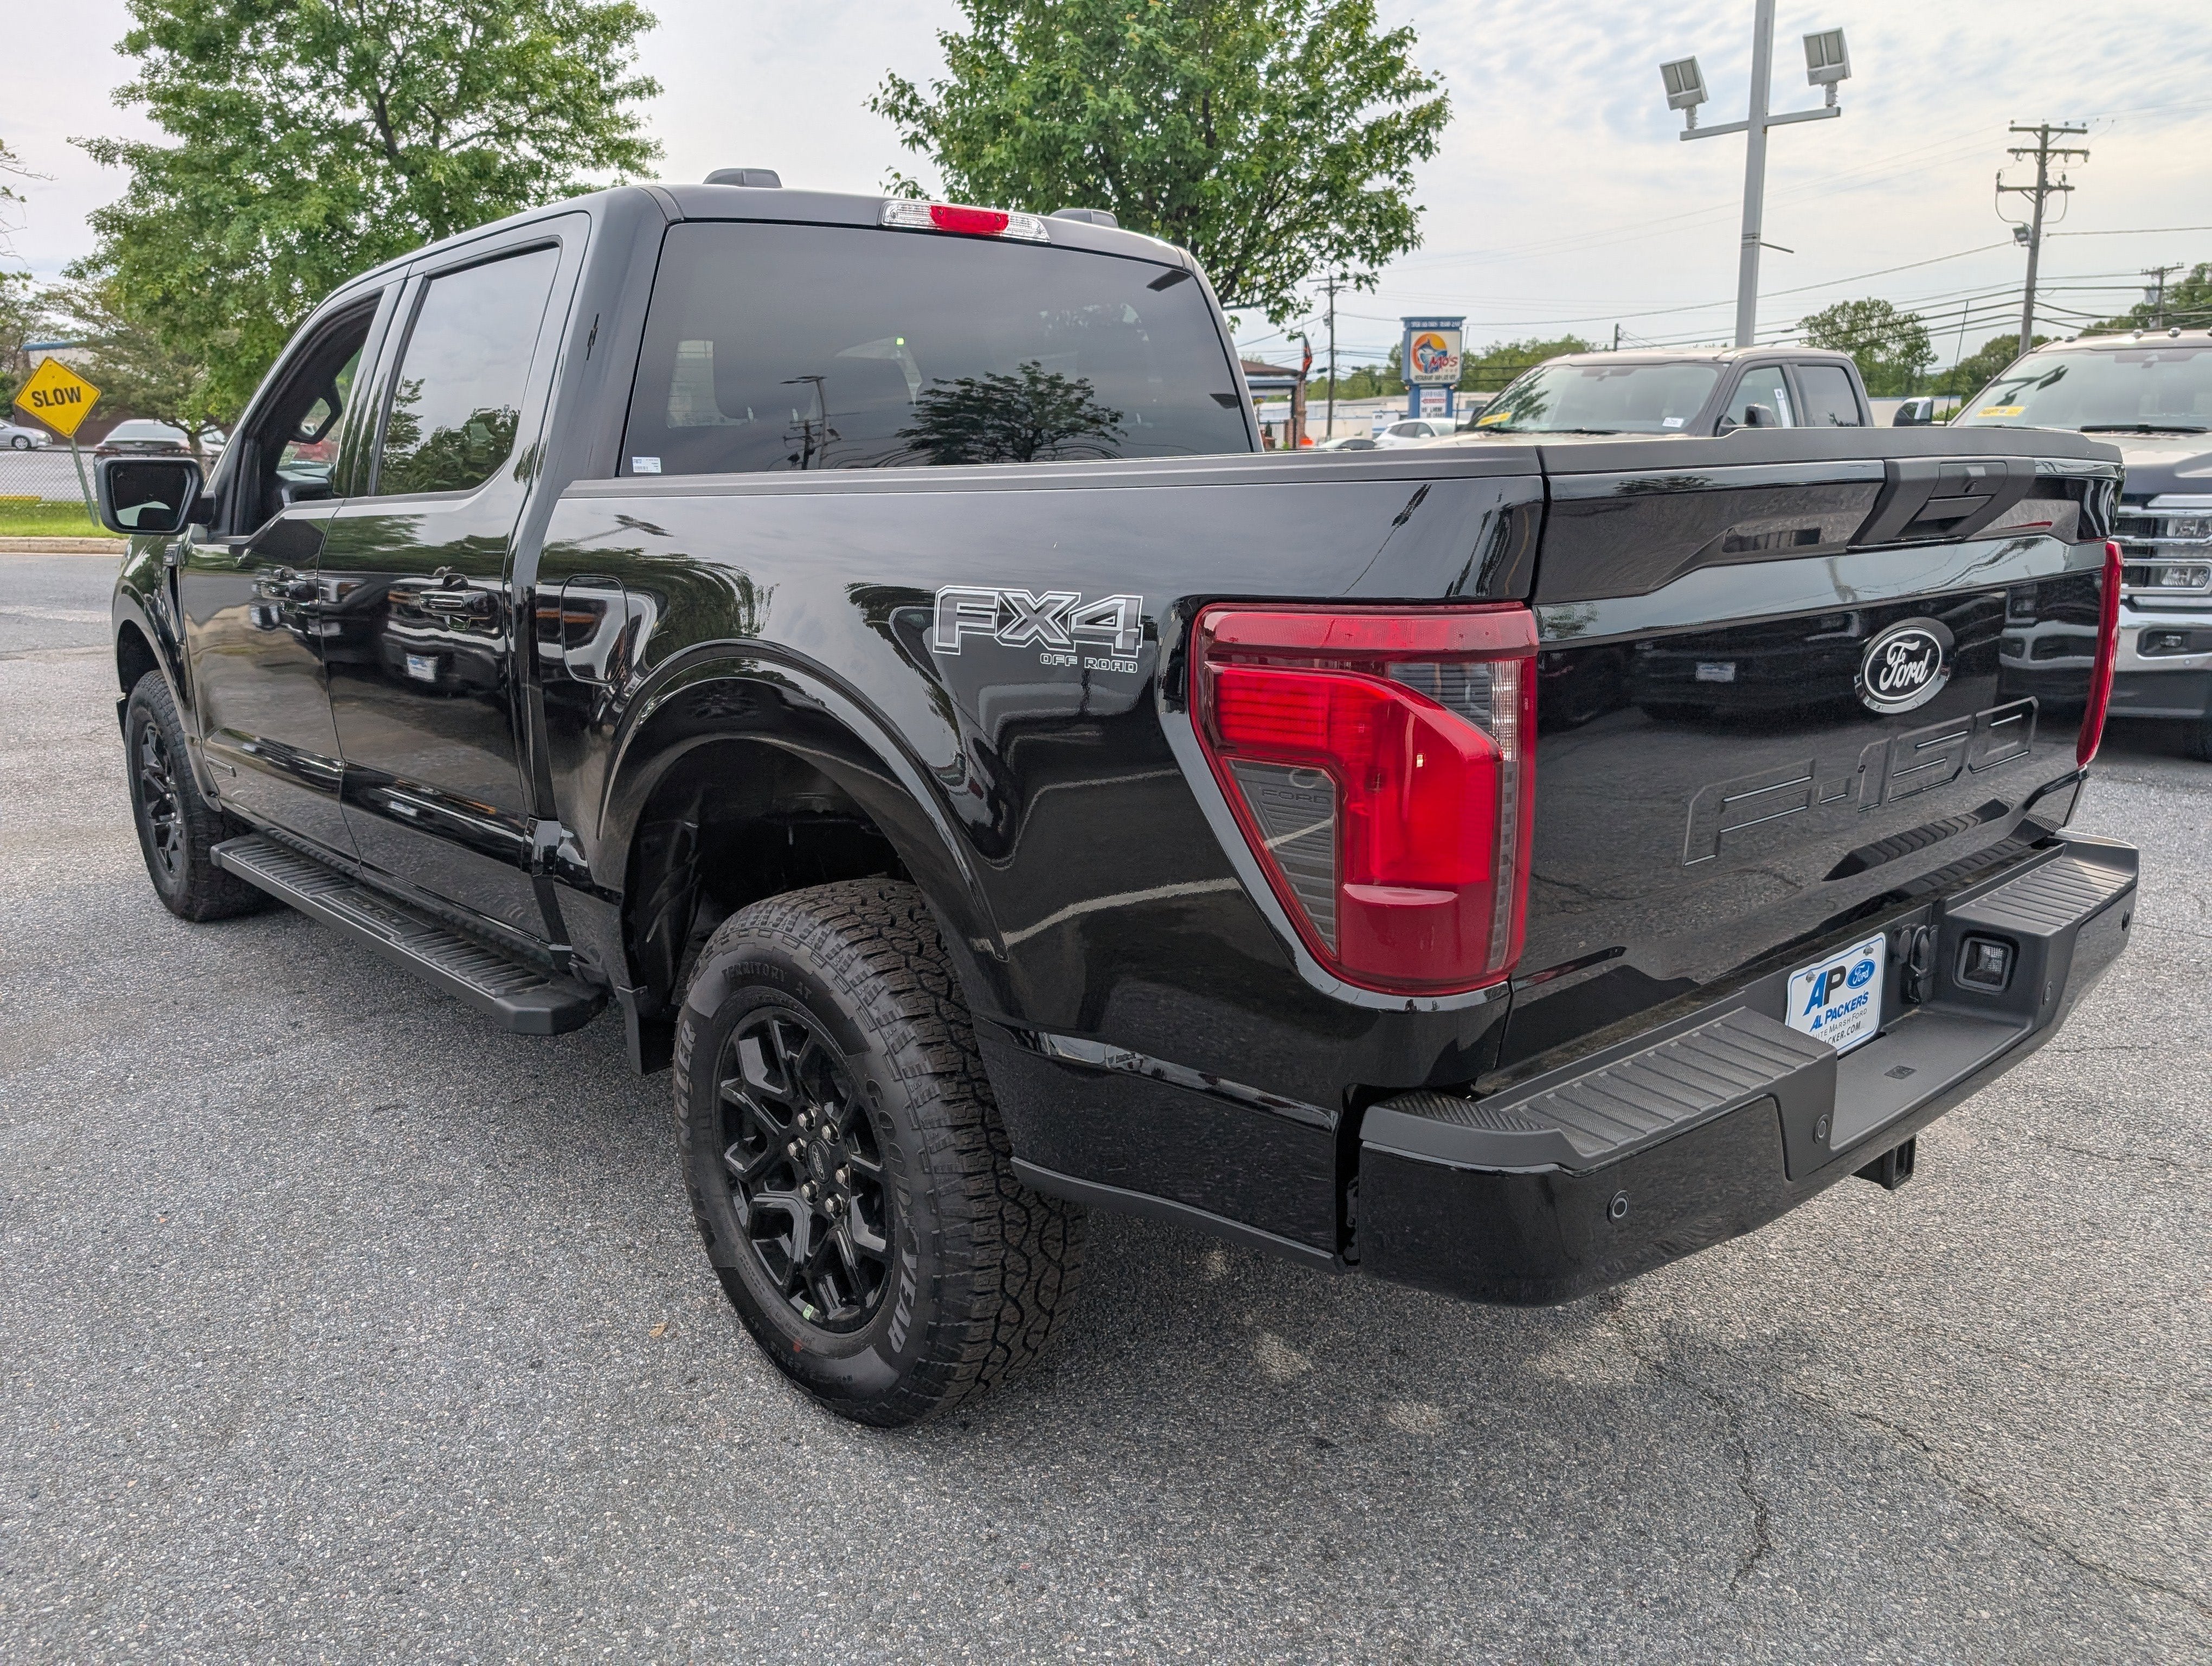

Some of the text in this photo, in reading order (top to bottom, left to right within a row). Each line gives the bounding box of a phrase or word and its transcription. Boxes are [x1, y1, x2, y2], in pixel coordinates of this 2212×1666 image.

[31, 386, 81, 407] SLOW
[933, 585, 1143, 658] FX4
[1040, 653, 1138, 674] OFF ROAD
[1879, 640, 1931, 691] Ford
[1262, 789, 1331, 806] FORD
[1683, 696, 2039, 867] F-150
[1802, 964, 1870, 1017] AP Ford
[1809, 990, 1869, 1033] AL PACKER'S
[1829, 1017, 1851, 1034] MARSH
[1851, 1008, 1868, 1022] FORD
[866, 1079, 919, 1354] GOODYEAR
